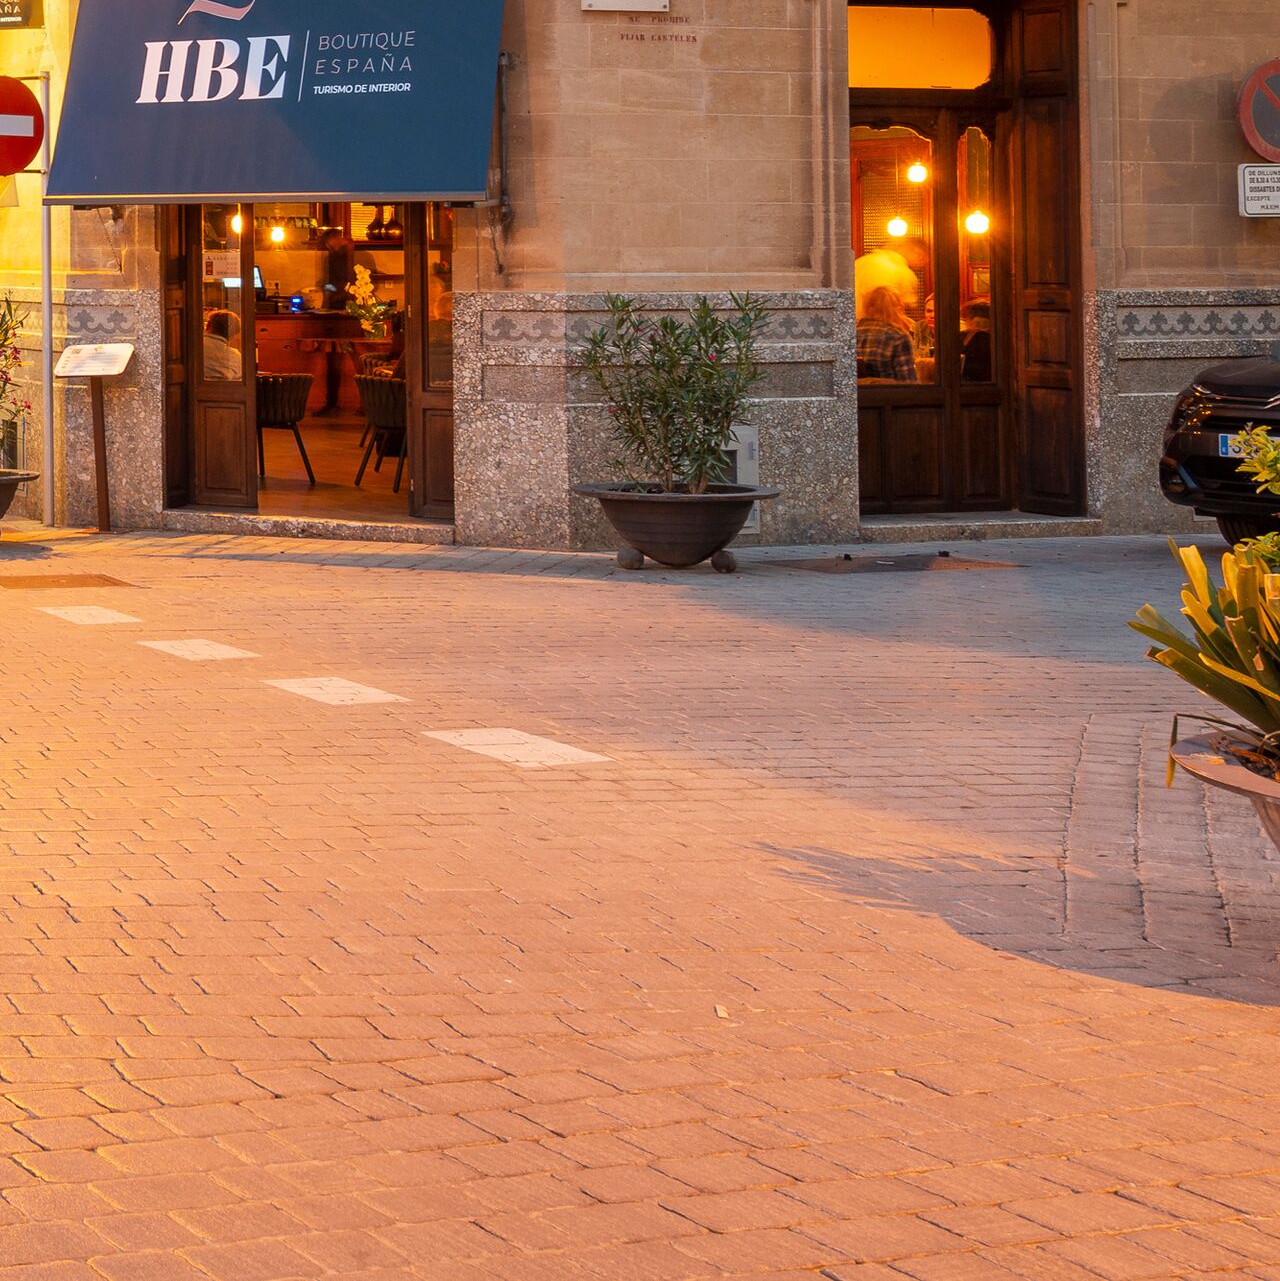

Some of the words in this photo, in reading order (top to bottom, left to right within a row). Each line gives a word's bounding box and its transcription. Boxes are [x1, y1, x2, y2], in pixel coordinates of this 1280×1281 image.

[318, 30, 416, 51] BOUTIQUE
[135, 34, 290, 104] HBE
[315, 53, 413, 75] ESPAÑA
[313, 85, 353, 94] TURISMO
[354, 84, 367, 93] DE
[368, 83, 411, 93] INTERIOR
